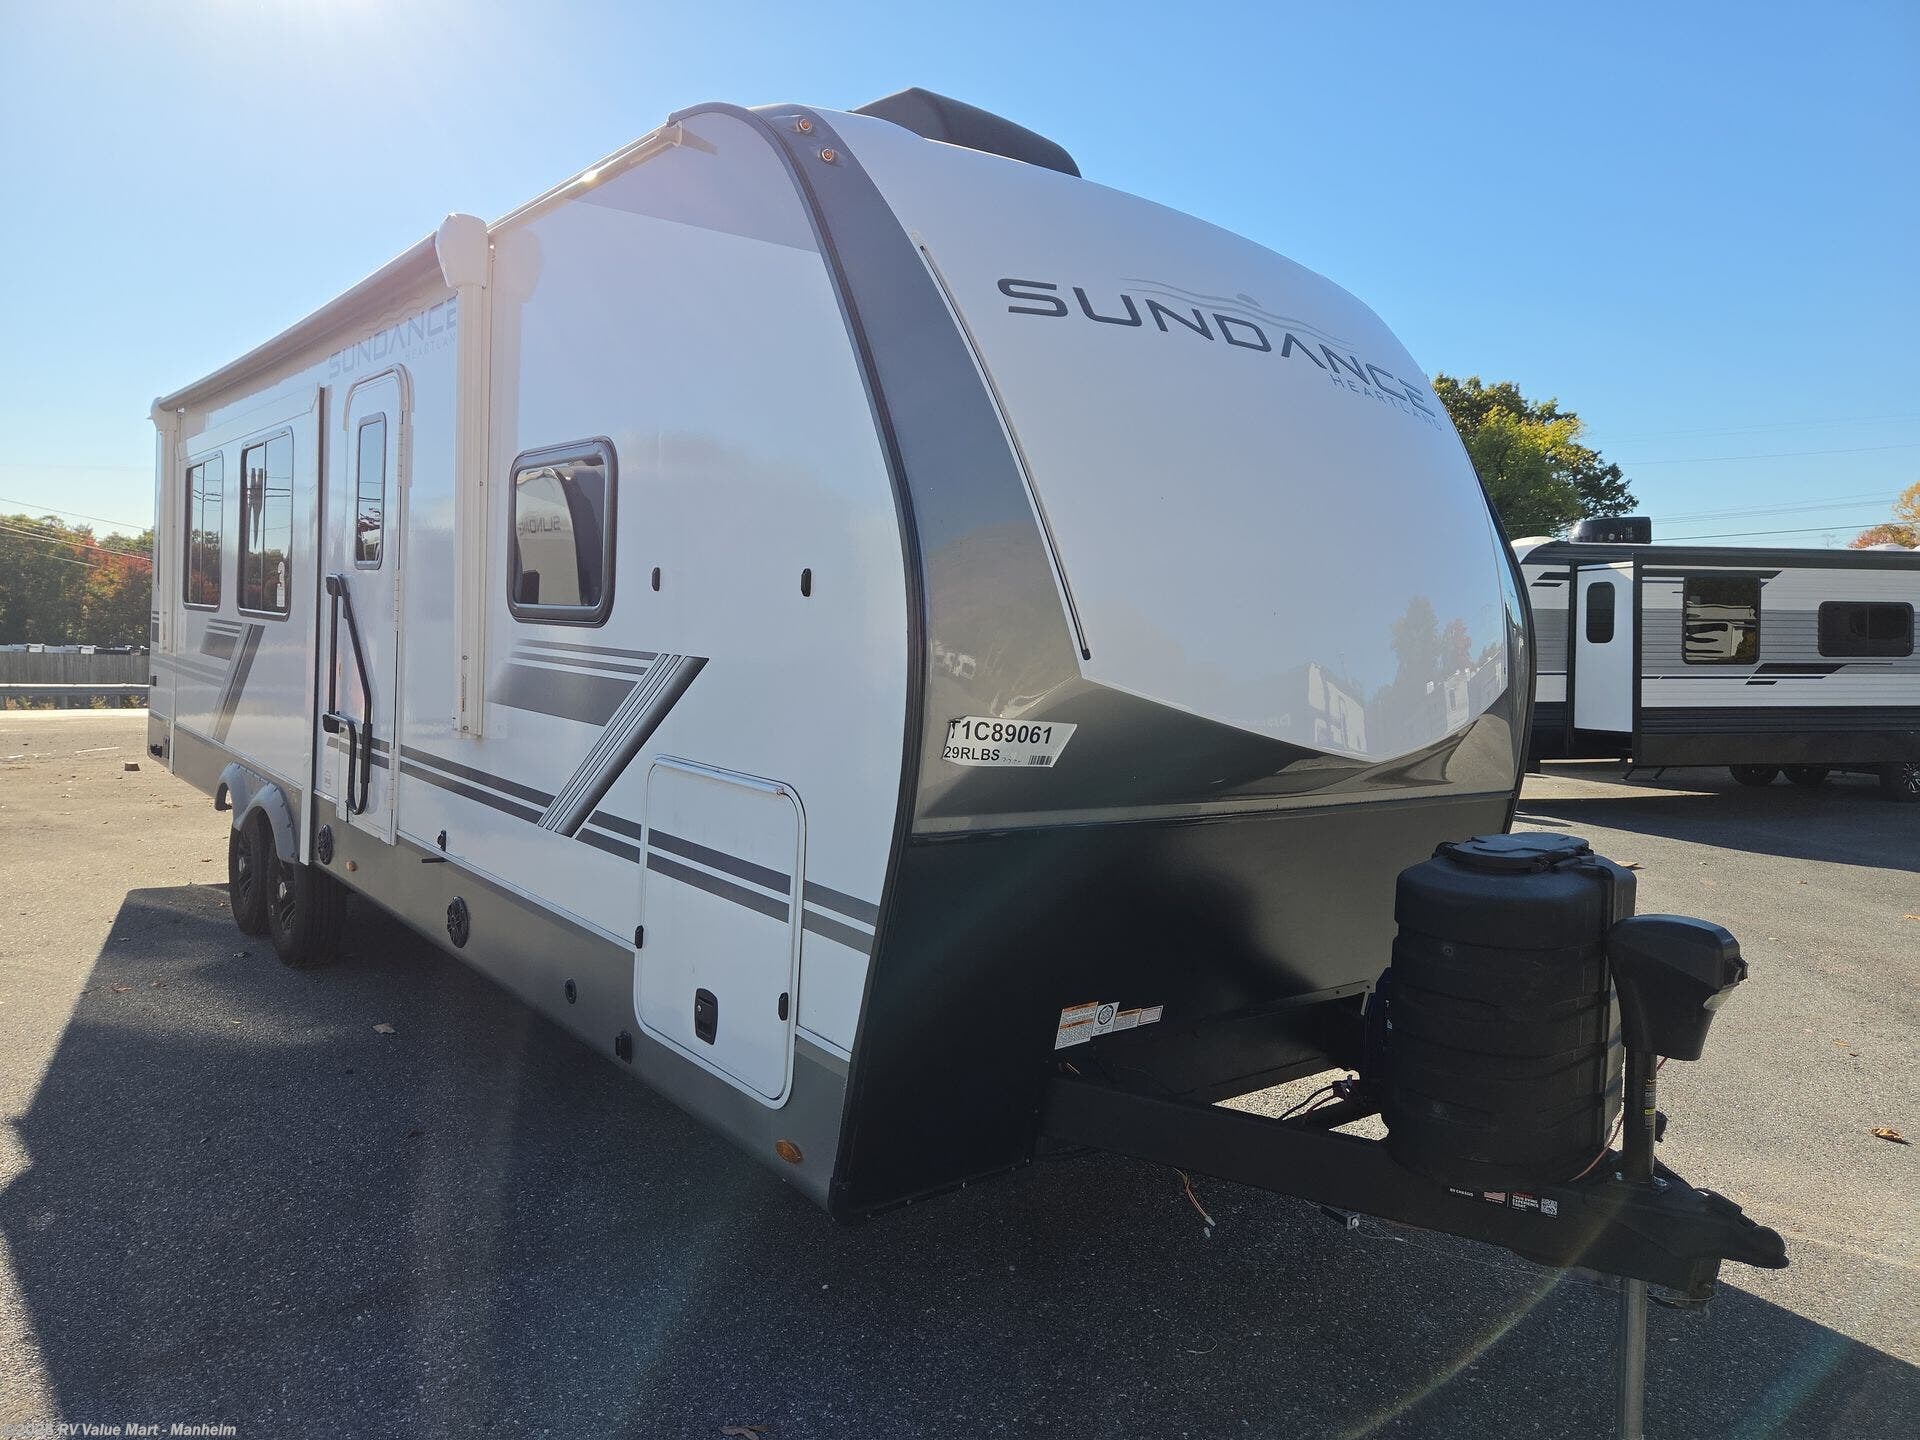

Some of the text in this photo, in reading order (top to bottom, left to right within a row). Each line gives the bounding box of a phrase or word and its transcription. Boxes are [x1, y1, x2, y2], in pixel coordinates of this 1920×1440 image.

[329, 296, 457, 379] SUNDANCE
[405, 332, 457, 361] HEARTLAN
[997, 278, 1436, 418] SUNDANCE
[1329, 373, 1443, 432] HEARTLAND
[943, 746, 1000, 761] 29RLBS
[948, 720, 1053, 745] T1C89061
